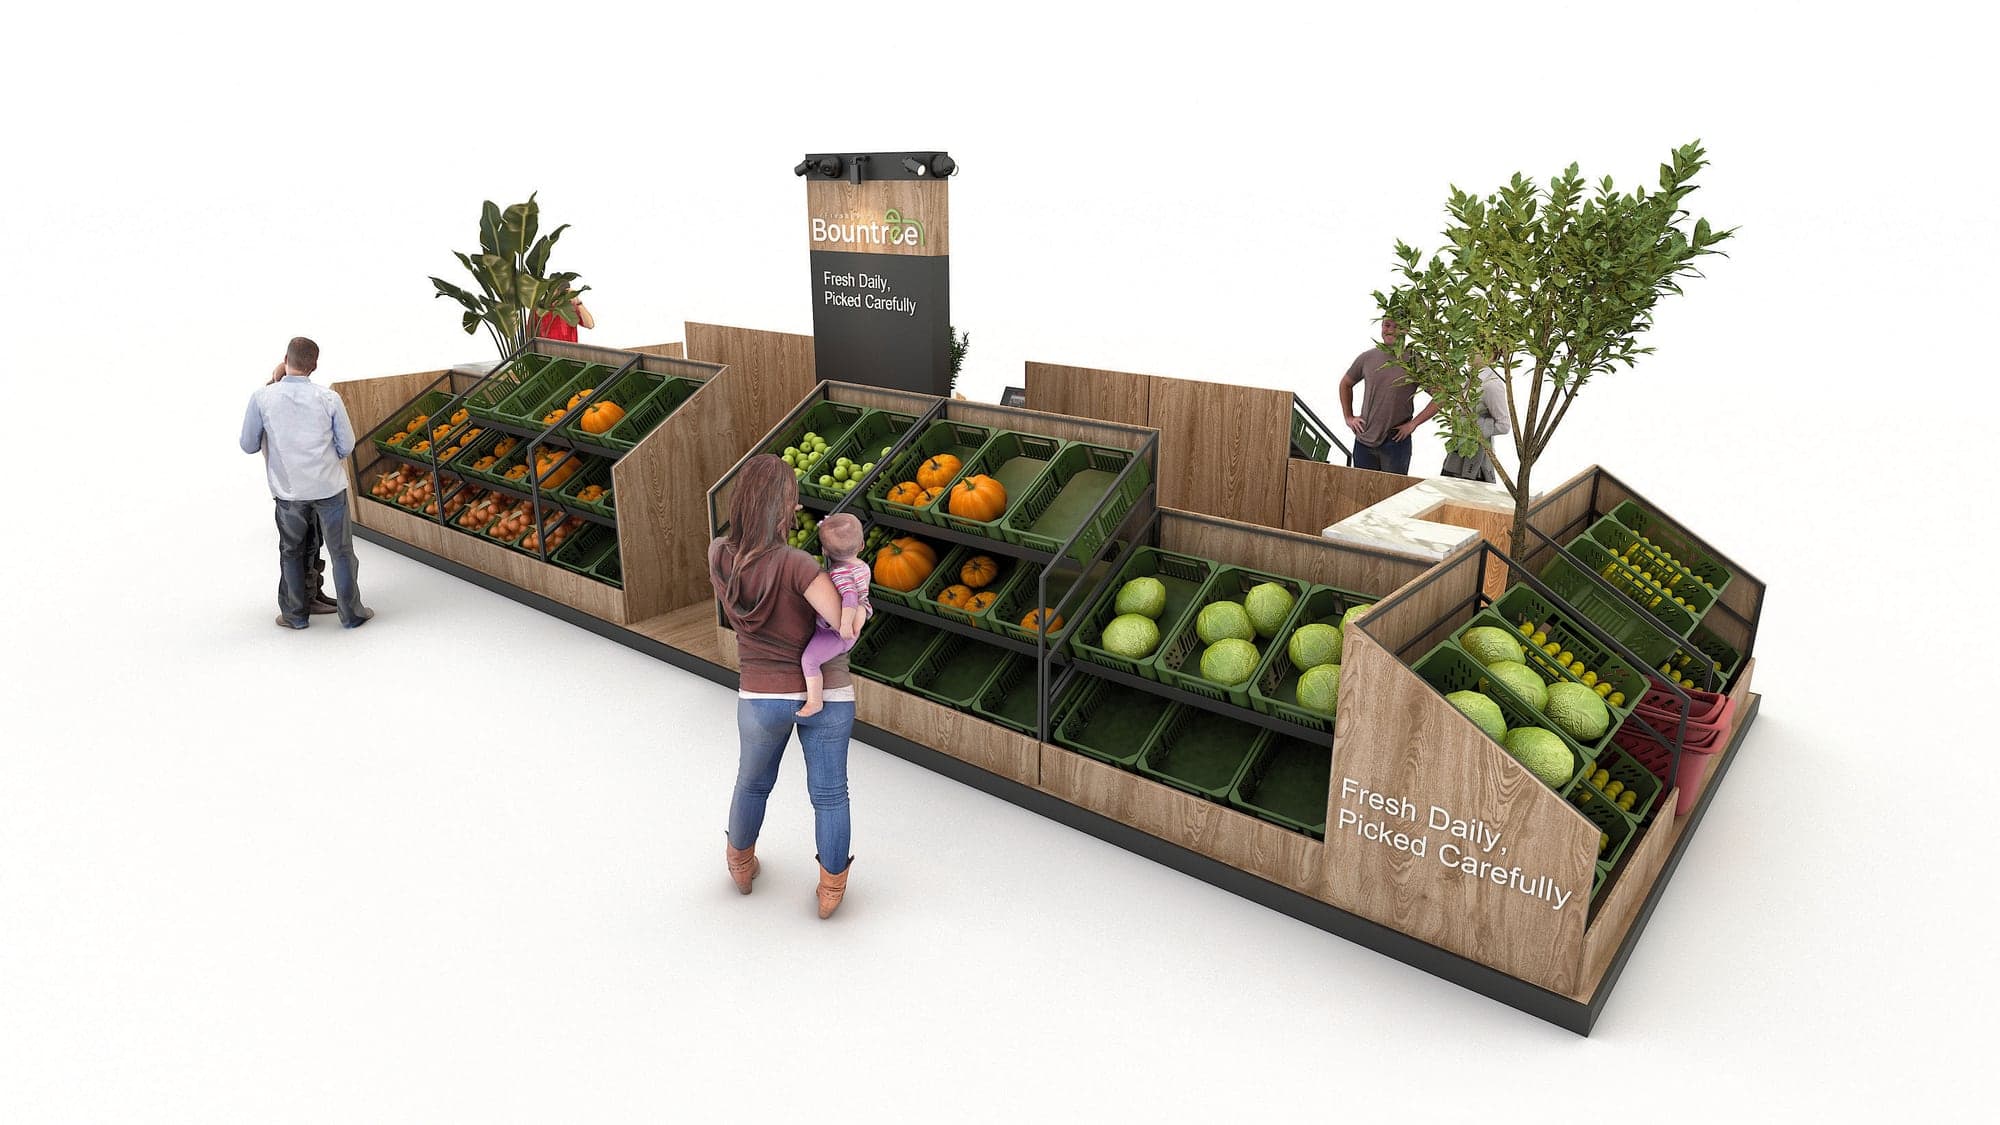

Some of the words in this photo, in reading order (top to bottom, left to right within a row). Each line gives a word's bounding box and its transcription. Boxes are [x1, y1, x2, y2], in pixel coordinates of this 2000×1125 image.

[812, 217, 919, 246] Bountree
[824, 271, 855, 287] Fresh
[859, 273, 891, 292] Daily,
[824, 291, 862, 308] Picked
[865, 294, 917, 316] Carefully
[1341, 777, 1417, 822] Fresh
[1429, 805, 1508, 856] Daily,
[1338, 808, 1427, 858] Picked
[1439, 844, 1572, 911] Carefully
